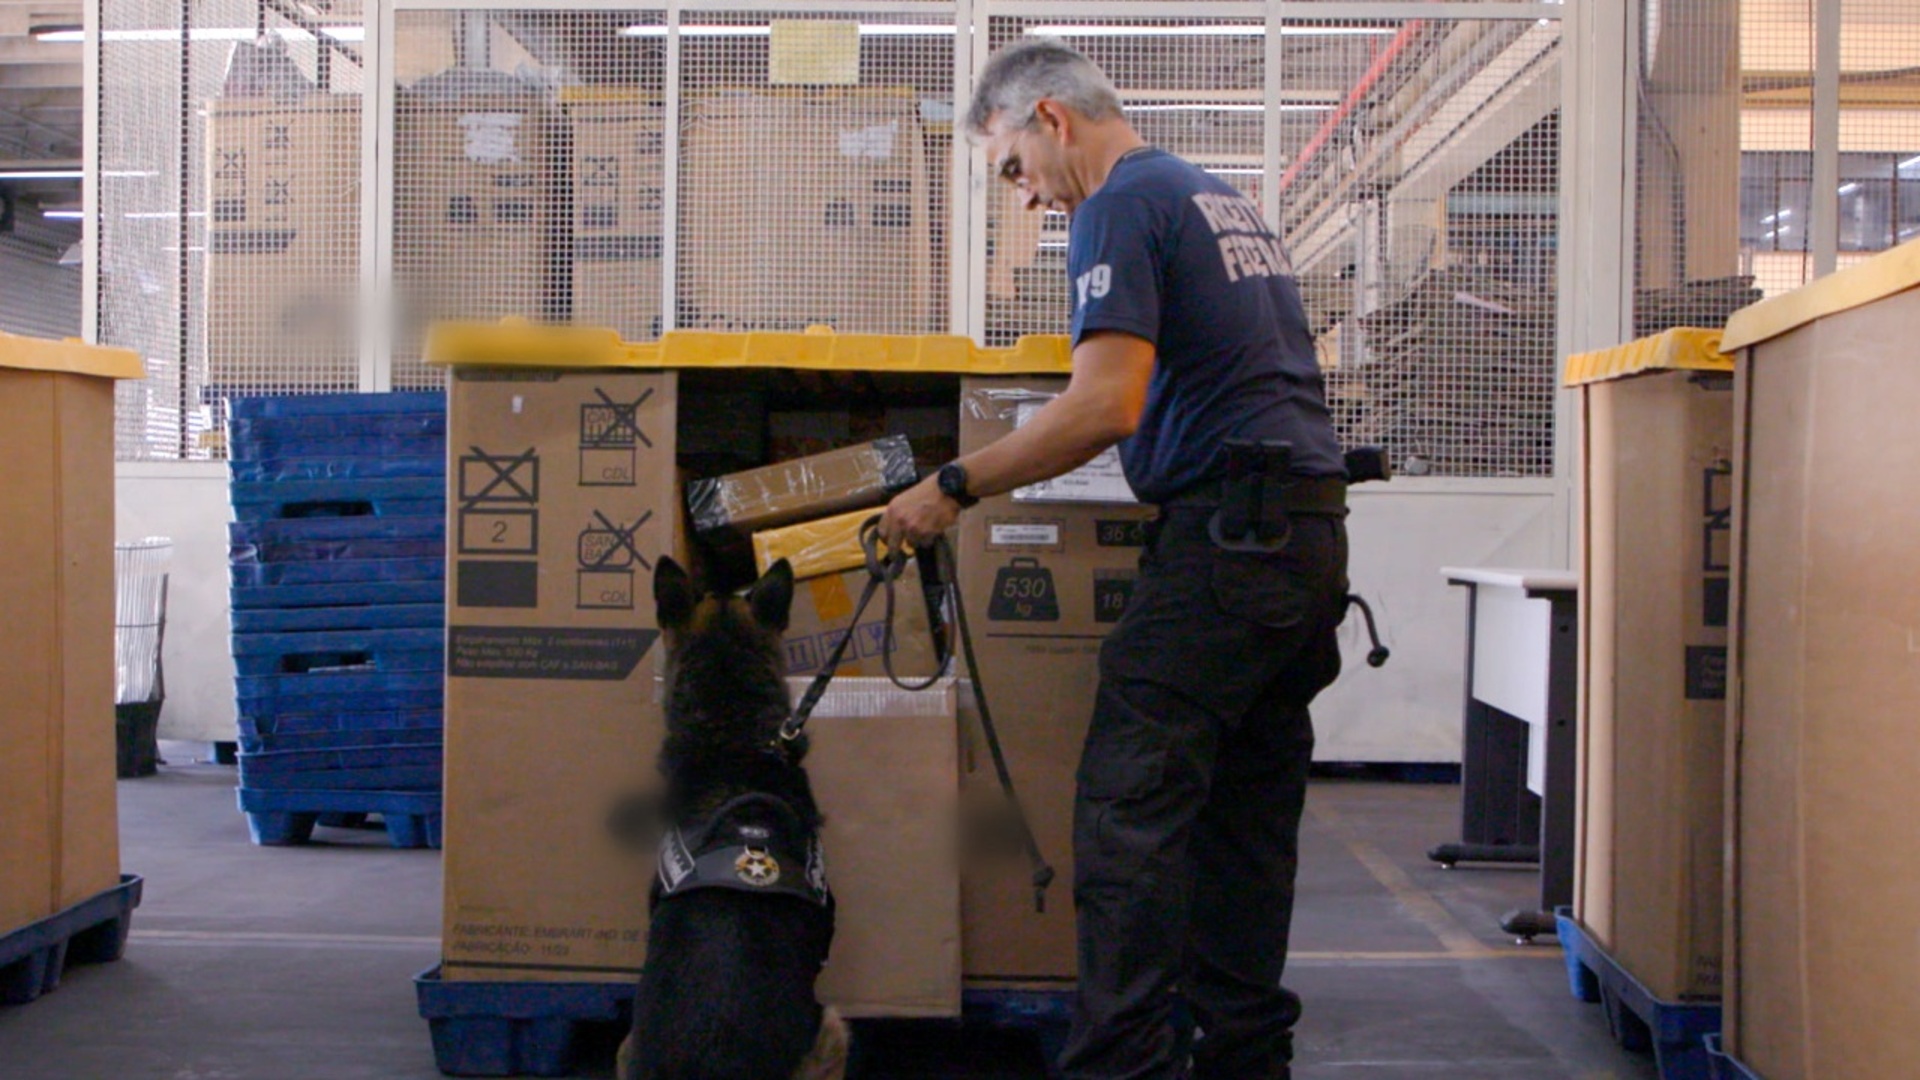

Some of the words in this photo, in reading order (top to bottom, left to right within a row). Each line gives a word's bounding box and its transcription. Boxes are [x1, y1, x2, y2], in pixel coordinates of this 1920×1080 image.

[491, 520, 508, 543] 2
[583, 548, 614, 561] BA
[1002, 577, 1047, 599] 530
[1014, 600, 1033, 619] kg
[1102, 591, 1125, 610] 18
